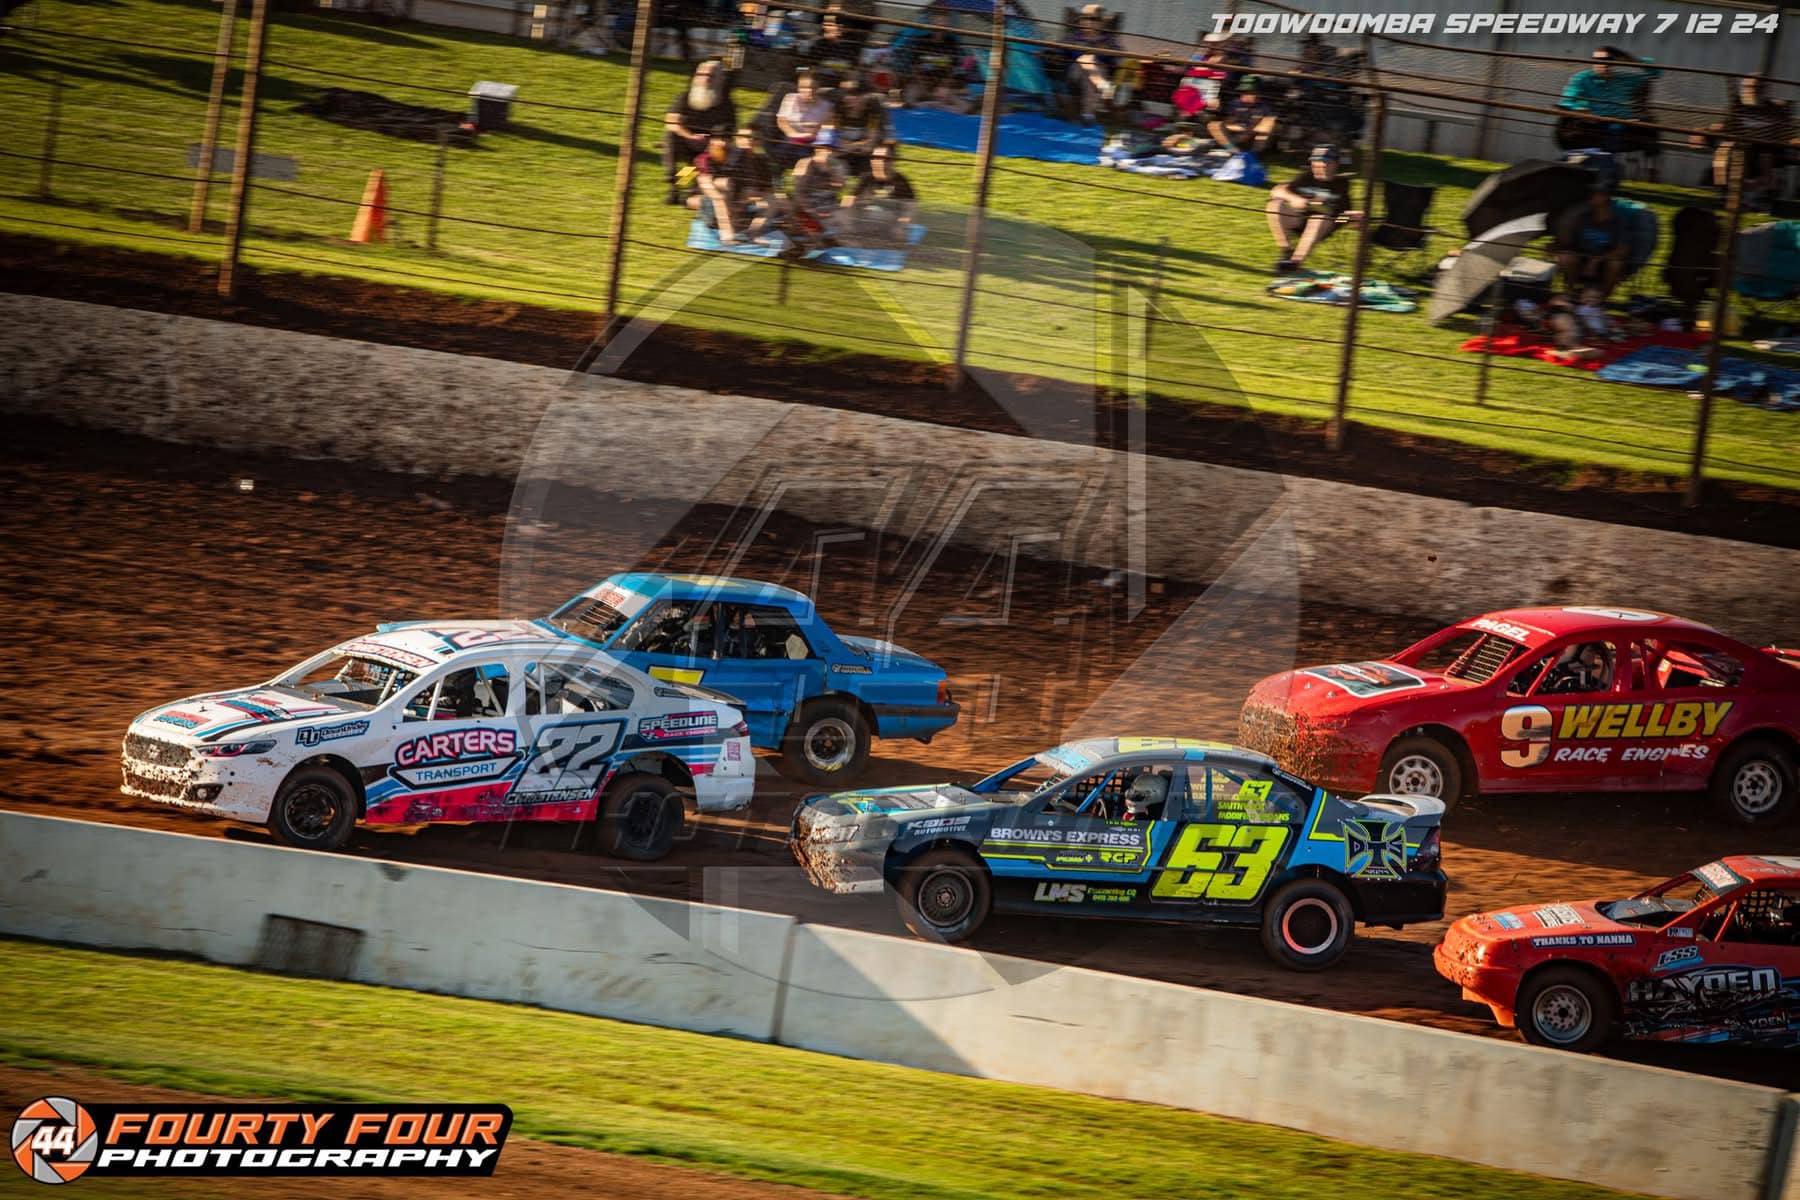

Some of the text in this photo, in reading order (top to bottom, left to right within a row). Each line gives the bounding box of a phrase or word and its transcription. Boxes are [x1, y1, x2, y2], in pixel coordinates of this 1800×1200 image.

[1470, 618, 1530, 642] PAGEL
[640, 714, 717, 730] SPEEDLINE
[1557, 701, 1734, 740] WELLBY
[1500, 704, 1553, 769] 9
[397, 729, 516, 766] CARTERS
[514, 722, 620, 792] 22
[1553, 743, 1710, 763] RACE ENGINES
[415, 761, 498, 782] TRANSPORT
[913, 825, 967, 837] AUTOMOTIVE
[990, 827, 1140, 846] BROWN'S EXPRESS
[1151, 823, 1289, 900] 63
[1033, 882, 1087, 903] LMS
[1532, 934, 1633, 948] THANKS TO NANNA
